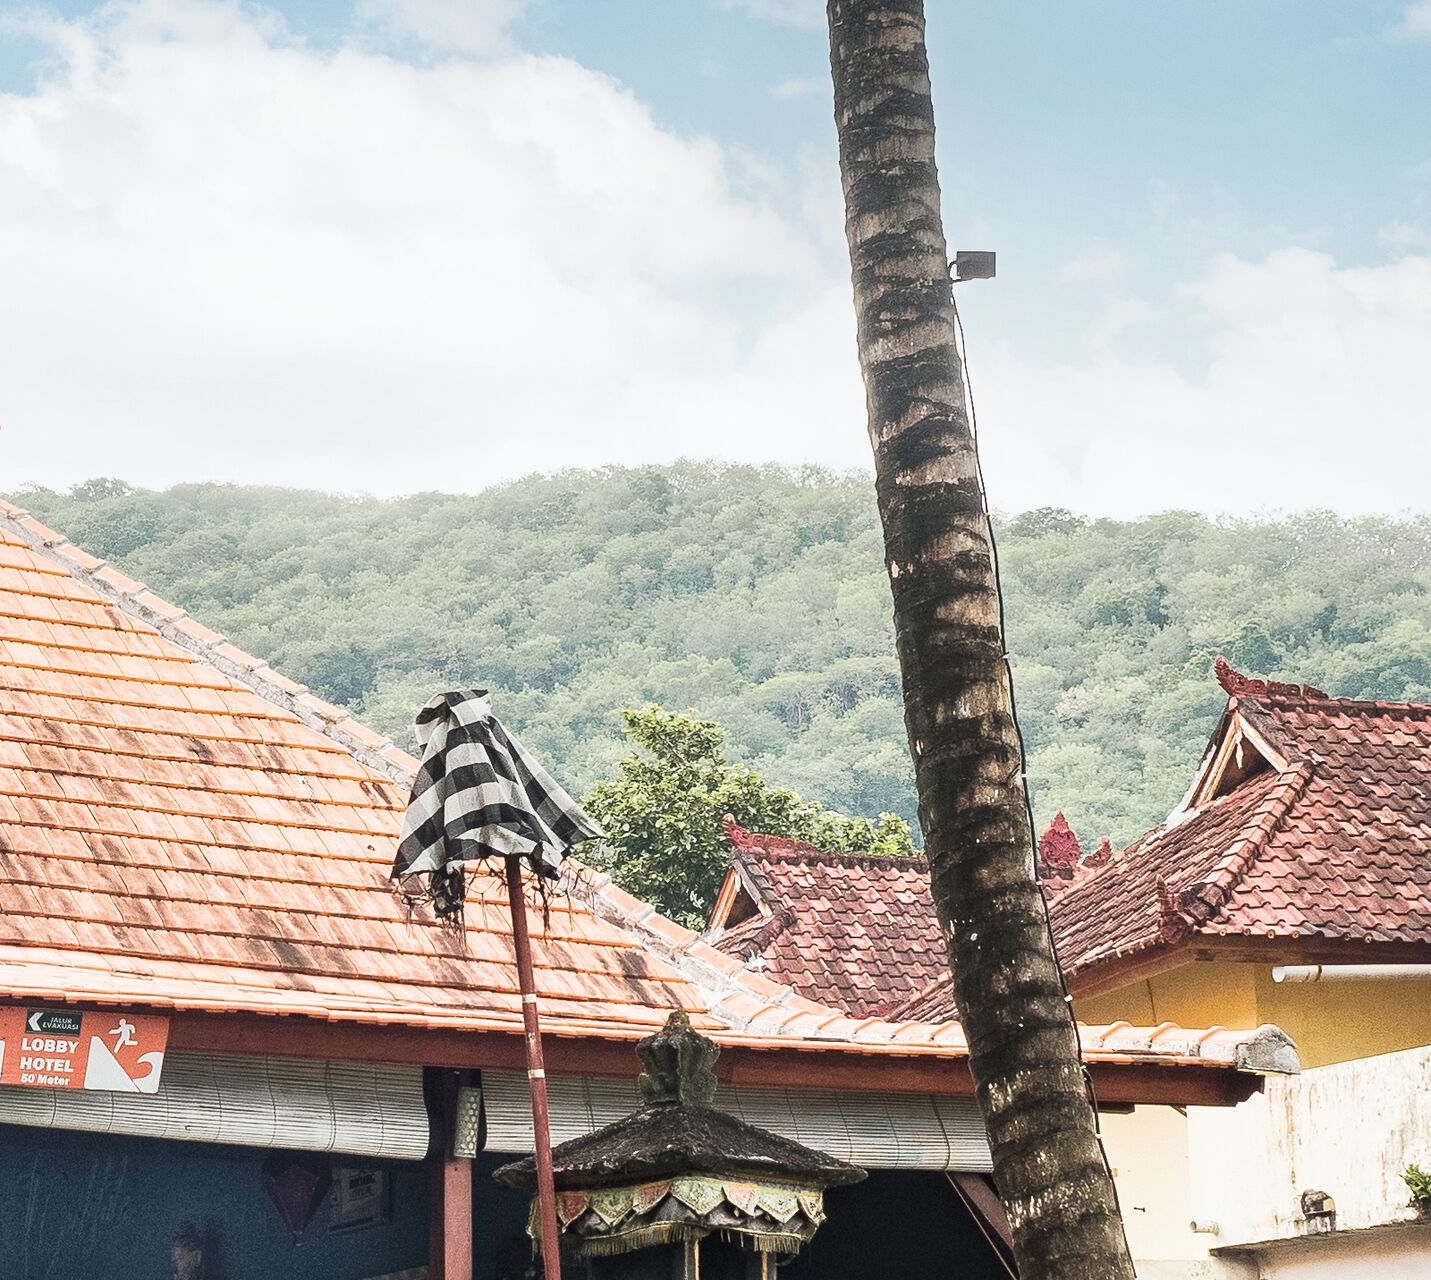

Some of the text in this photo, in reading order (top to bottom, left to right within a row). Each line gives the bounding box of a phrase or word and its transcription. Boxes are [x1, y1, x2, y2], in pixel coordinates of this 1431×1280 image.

[21, 1037, 79, 1053] LOBBY
[20, 1056, 74, 1072] HOTEL
[21, 1073, 35, 1083] 50
